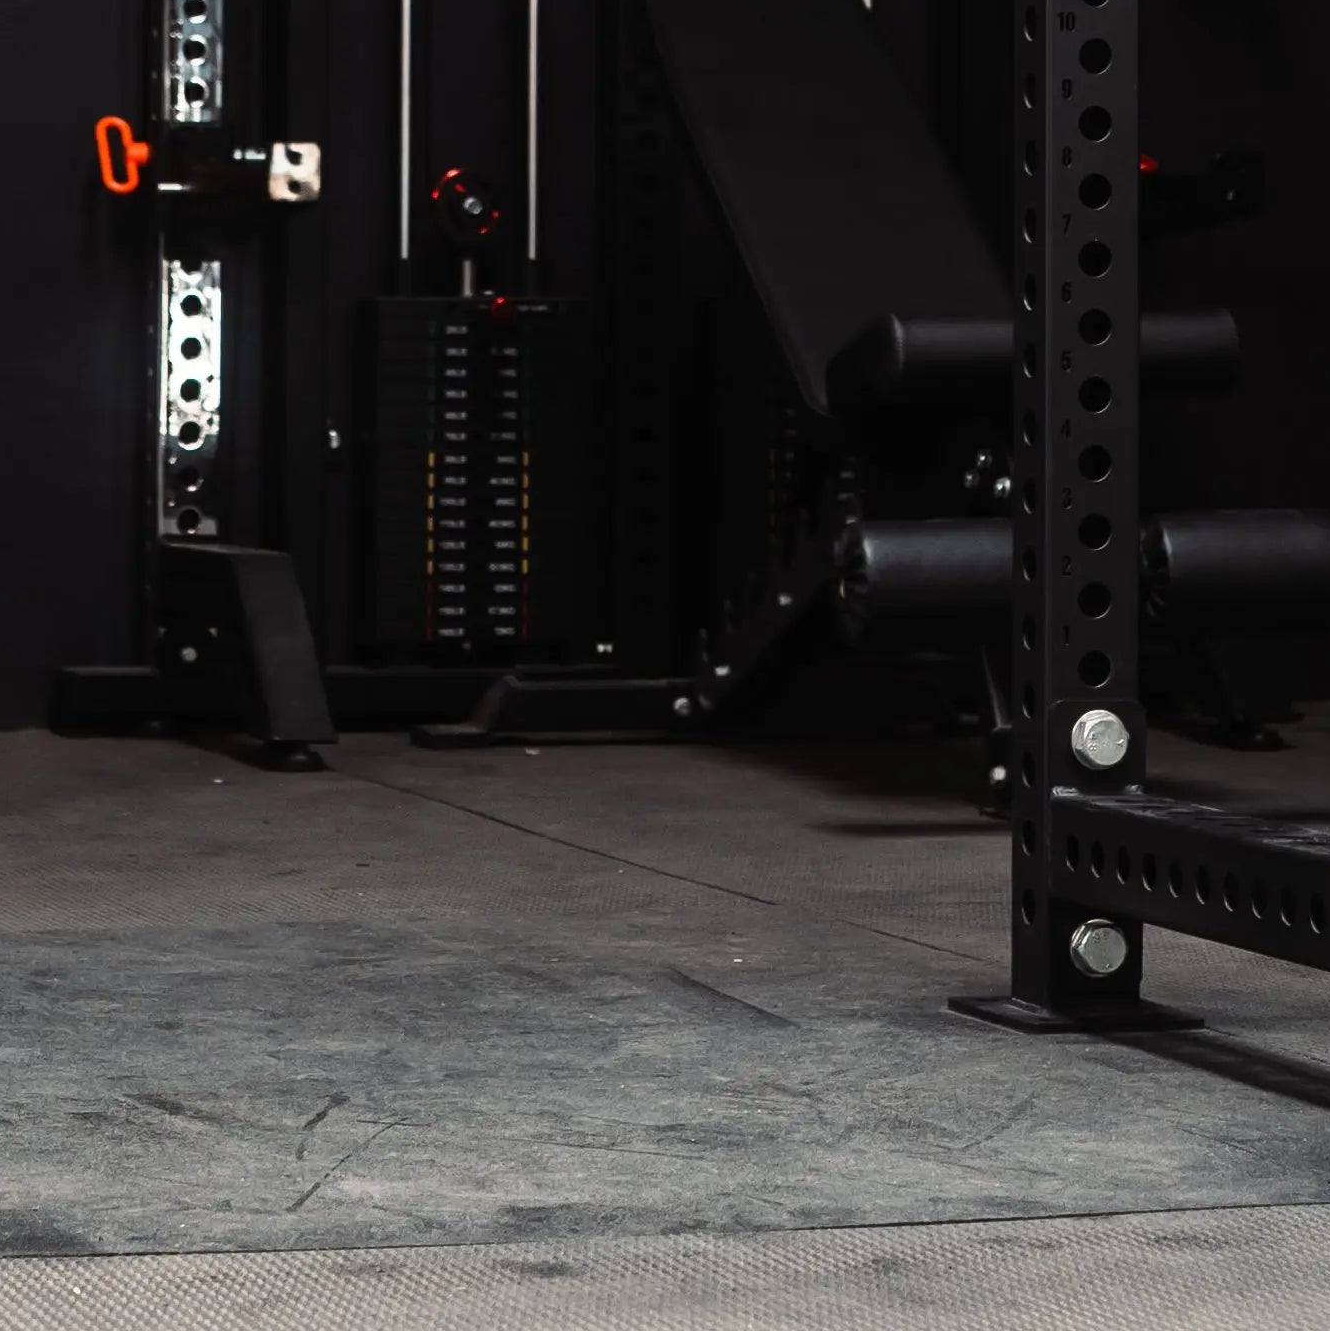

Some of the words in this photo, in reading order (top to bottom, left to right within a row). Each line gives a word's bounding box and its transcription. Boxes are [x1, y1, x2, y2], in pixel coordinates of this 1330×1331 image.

[1058, 12, 1076, 31] 10
[1061, 78, 1072, 99] 9
[1061, 146, 1072, 167] 8
[1061, 214, 1072, 235] 7
[1061, 282, 1072, 303] 6
[1061, 350, 1072, 372] 5
[1061, 488, 1072, 509] 3
[1061, 556, 1072, 576] 2
